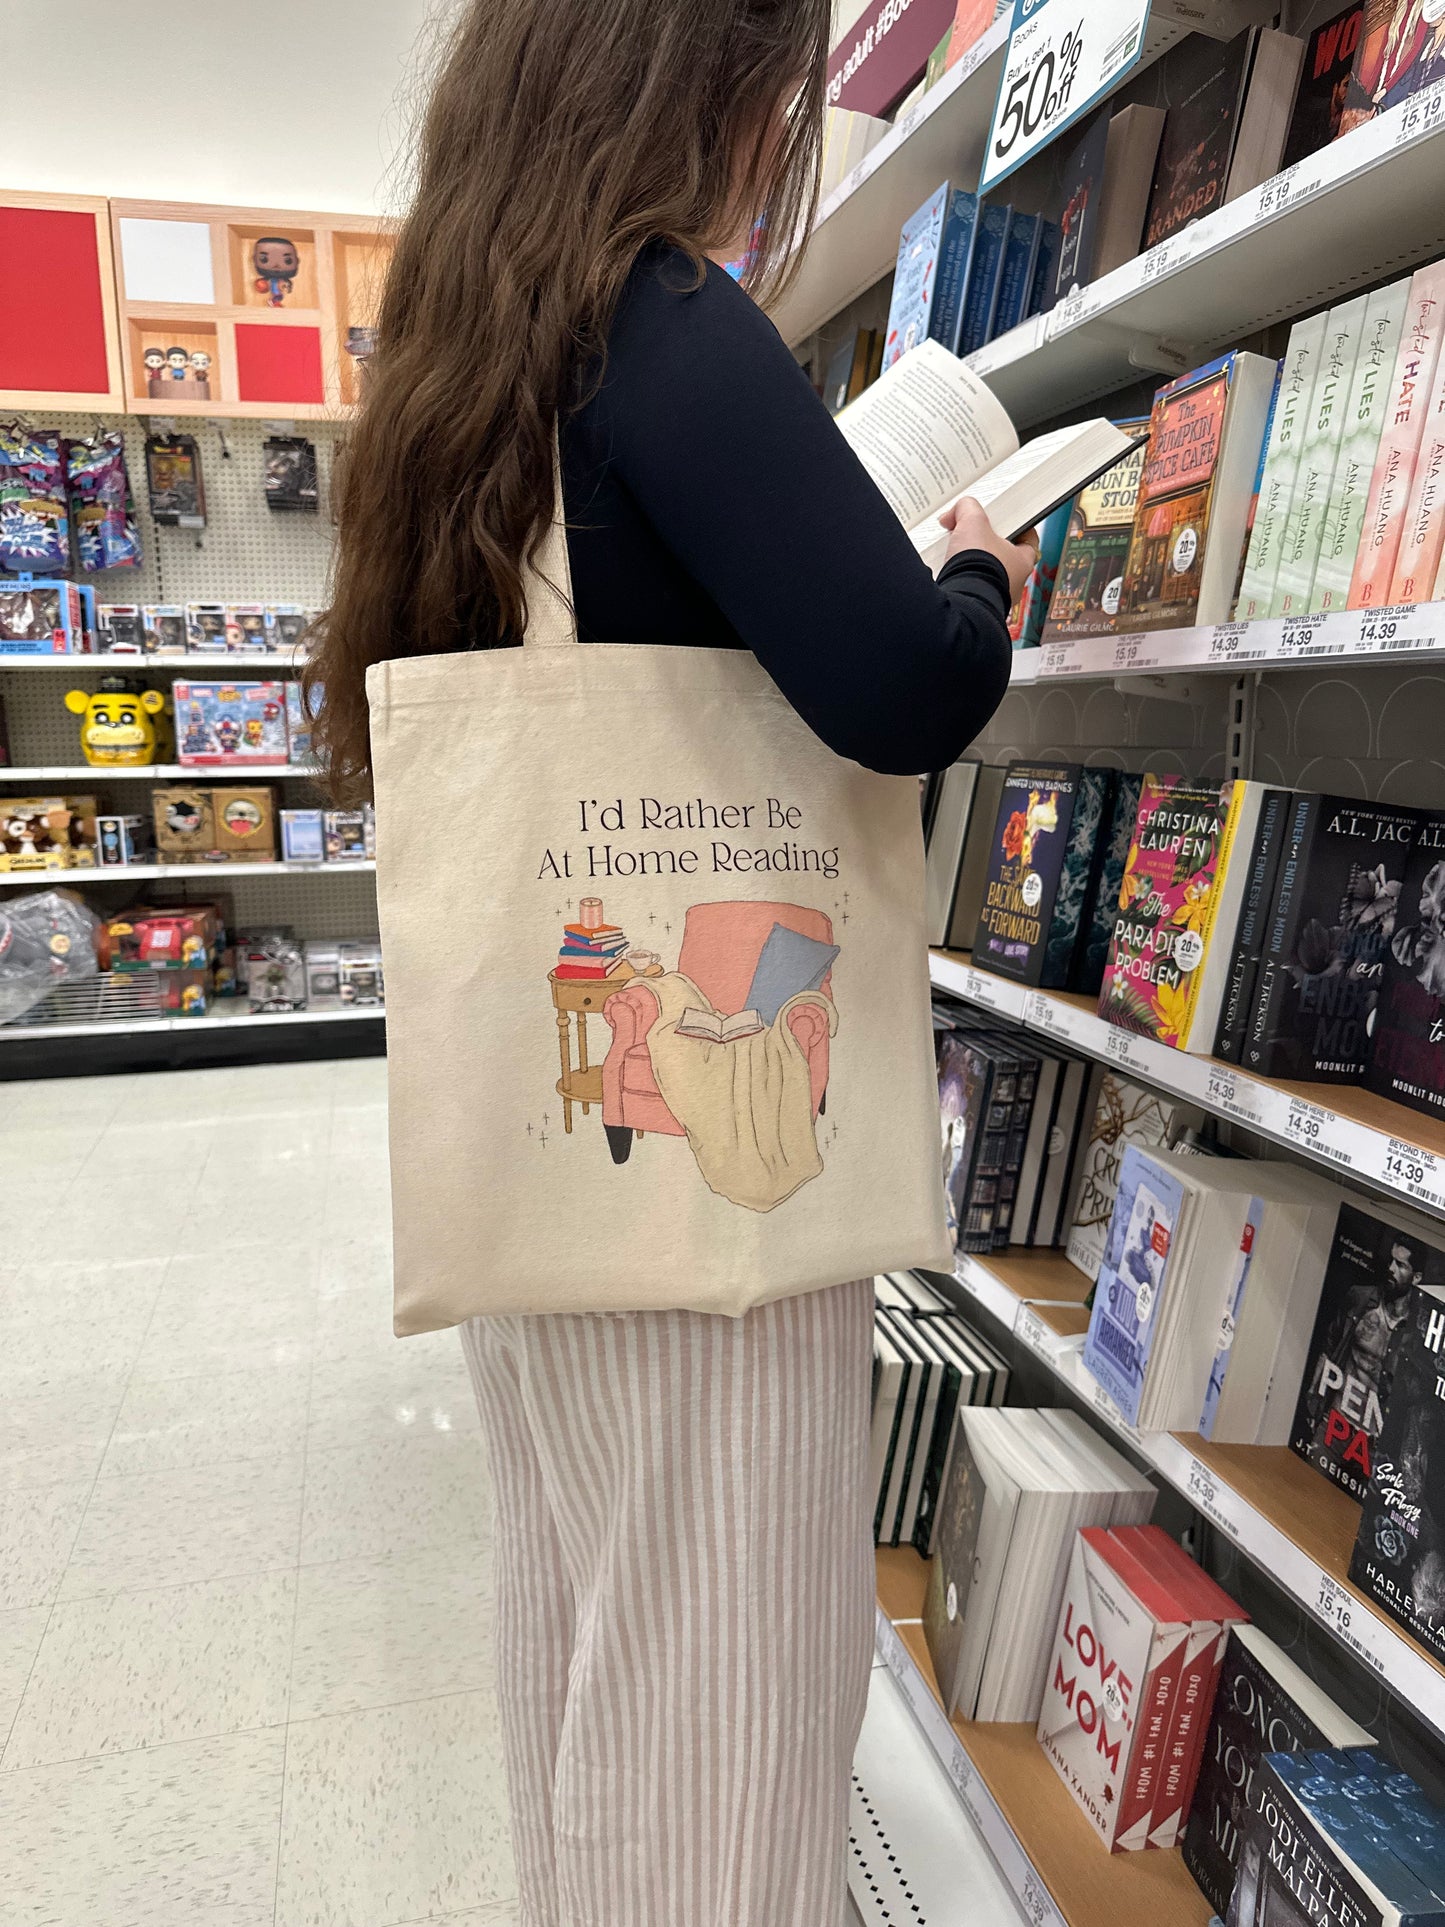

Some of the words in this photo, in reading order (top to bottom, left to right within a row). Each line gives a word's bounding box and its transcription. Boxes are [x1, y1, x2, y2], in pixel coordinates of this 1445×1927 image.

[842, 25, 874, 84] adult
[875, 0, 914, 45] #Boo
[1013, 21, 1038, 49] Books
[1006, 63, 1023, 83] Buy
[1031, 43, 1047, 65] get
[1044, 65, 1078, 120] off
[1401, 95, 1442, 132] 15.19
[1258, 181, 1290, 212] 15.19
[1143, 251, 1168, 276] 15.19
[1317, 382, 1338, 431] LIES
[1357, 369, 1379, 421] LIES
[1394, 360, 1421, 426] HATE
[1177, 401, 1197, 422] The
[1280, 396, 1298, 443] LIES
[1155, 412, 1215, 456] PUMPKIN
[1144, 452, 1178, 486] SPICE
[1385, 449, 1401, 484] ANA
[1429, 443, 1445, 479] ANA
[1091, 474, 1125, 492] BUN
[1304, 471, 1319, 504] ANA
[1344, 463, 1360, 496] ANA
[1100, 489, 1139, 509] STOR
[1266, 482, 1281, 512] ANA
[1334, 500, 1352, 557] HUANG
[1374, 489, 1393, 548] HUANG
[1415, 484, 1437, 545] HUANG
[1256, 517, 1275, 569] HUANG
[1294, 508, 1312, 561] HUANG
[1214, 623, 1236, 632] TWISTED
[1236, 621, 1249, 631] LIES
[1284, 616, 1311, 625] TWISTED
[1311, 613, 1328, 624] HATE
[1364, 607, 1394, 618] TWISTED
[1395, 604, 1417, 616] GAME
[1061, 623, 1089, 634] LAURIE
[1211, 637, 1239, 653] 14.39
[1281, 629, 1313, 647] 14.39
[1360, 622, 1397, 641] 14.39
[1115, 646, 1138, 660] 15.19
[1028, 779, 1045, 791] LYNN
[1045, 779, 1074, 794] BARNES
[578, 798, 626, 832] I'd
[639, 797, 756, 830] Rather
[765, 797, 802, 829] Be
[1138, 809, 1218, 835] CHRISTINA
[1263, 799, 1278, 840] UNDER
[1294, 801, 1310, 844] UNDER
[1327, 815, 1366, 837] A.L.
[1371, 822, 1412, 843] JAC
[1340, 809, 1356, 817] NEW
[1356, 811, 1375, 820] YORK
[537, 848, 573, 880] At
[586, 845, 699, 878] Home
[710, 841, 840, 880] Reading
[1139, 831, 1206, 858] LAUREN
[1000, 864, 1013, 881] THE
[1250, 855, 1268, 914] ENDLESS
[1279, 860, 1298, 917] ENDLESS
[1143, 891, 1170, 917] The
[988, 909, 1041, 946] FORWARD
[1241, 913, 1257, 945] MOON
[1270, 917, 1287, 953] MOON
[1114, 952, 1179, 989] PROBLEM
[1356, 961, 1383, 978] an
[1224, 976, 1243, 1032] JACKSON
[1253, 983, 1274, 1042] JACKSON
[1107, 1035, 1129, 1053] 15.19
[1315, 1060, 1355, 1073] MOONLIT
[1208, 1078, 1235, 1101] 14.39
[1392, 1078, 1427, 1099] MOONLIT
[1428, 1092, 1445, 1108] RIDG
[1287, 1112, 1320, 1138] 14.39
[1291, 1097, 1309, 1111] FROM
[1309, 1104, 1327, 1118] HERE
[1326, 1111, 1335, 1122] TO
[1389, 1138, 1420, 1158] BEYOND
[1420, 1150, 1435, 1164] THE
[1386, 1155, 1424, 1184] 14.39
[1070, 1242, 1098, 1272] HOLLY
[1087, 1354, 1112, 1389] LAUREN
[1295, 1438, 1315, 1461] J.T.
[1323, 1409, 1372, 1477] PA
[1189, 1471, 1215, 1502] 14.39
[1380, 1486, 1422, 1520] Trilogy
[1390, 1509, 1407, 1531] BOOK
[1406, 1522, 1420, 1539] ONE
[1321, 1573, 1336, 1591] HER
[1335, 1585, 1353, 1607] SOUL
[1366, 1562, 1424, 1617] HARLEY
[1428, 1617, 1445, 1643] LA
[1317, 1589, 1352, 1629] 15.16
[1372, 1583, 1408, 1619] NATIONALLY
[1408, 1616, 1445, 1653] BESTSELLIN
[1156, 1675, 1172, 1707] XOXO
[1185, 1673, 1202, 1705] XOXO
[1053, 1652, 1123, 1776] MOM
[1149, 1712, 1164, 1738] FAN.
[1178, 1709, 1193, 1736] FAN.
[1143, 1742, 1156, 1761] #1
[1172, 1740, 1185, 1759] #1
[1136, 1766, 1152, 1800] FROM
[1166, 1763, 1181, 1798] FROM
[1070, 1775, 1108, 1834] XANDER
[1256, 1792, 1301, 1860] JODI
[1272, 1791, 1283, 1806] NEW
[1281, 1804, 1296, 1826] YORK
[1294, 1824, 1311, 1847] TIMES
[1308, 1844, 1344, 1892] BESTSELLING
[1343, 1889, 1368, 1922] AUTHOR
[1268, 1837, 1331, 1927] MALPA
[1023, 1882, 1045, 1922] 14.39
